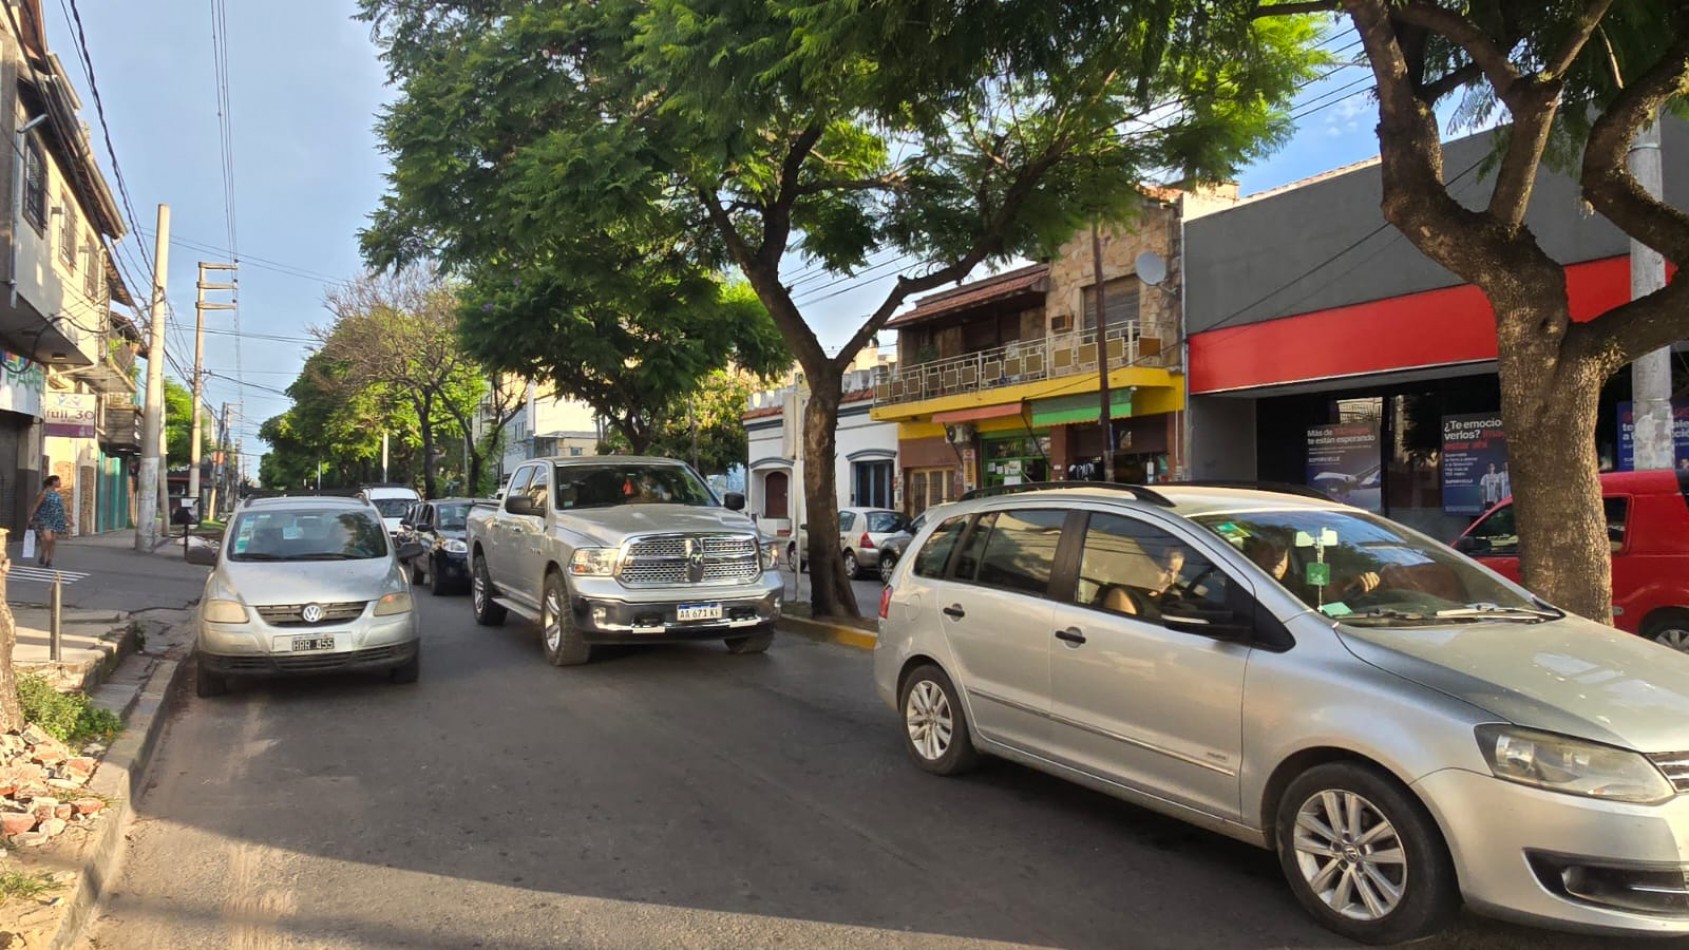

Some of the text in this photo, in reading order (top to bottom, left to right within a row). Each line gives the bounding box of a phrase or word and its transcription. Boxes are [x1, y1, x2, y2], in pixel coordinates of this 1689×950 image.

[1444, 418, 1503, 432] ¿Te emocio
[1336, 434, 1375, 444] esperando
[1444, 429, 1481, 440] verlos?
